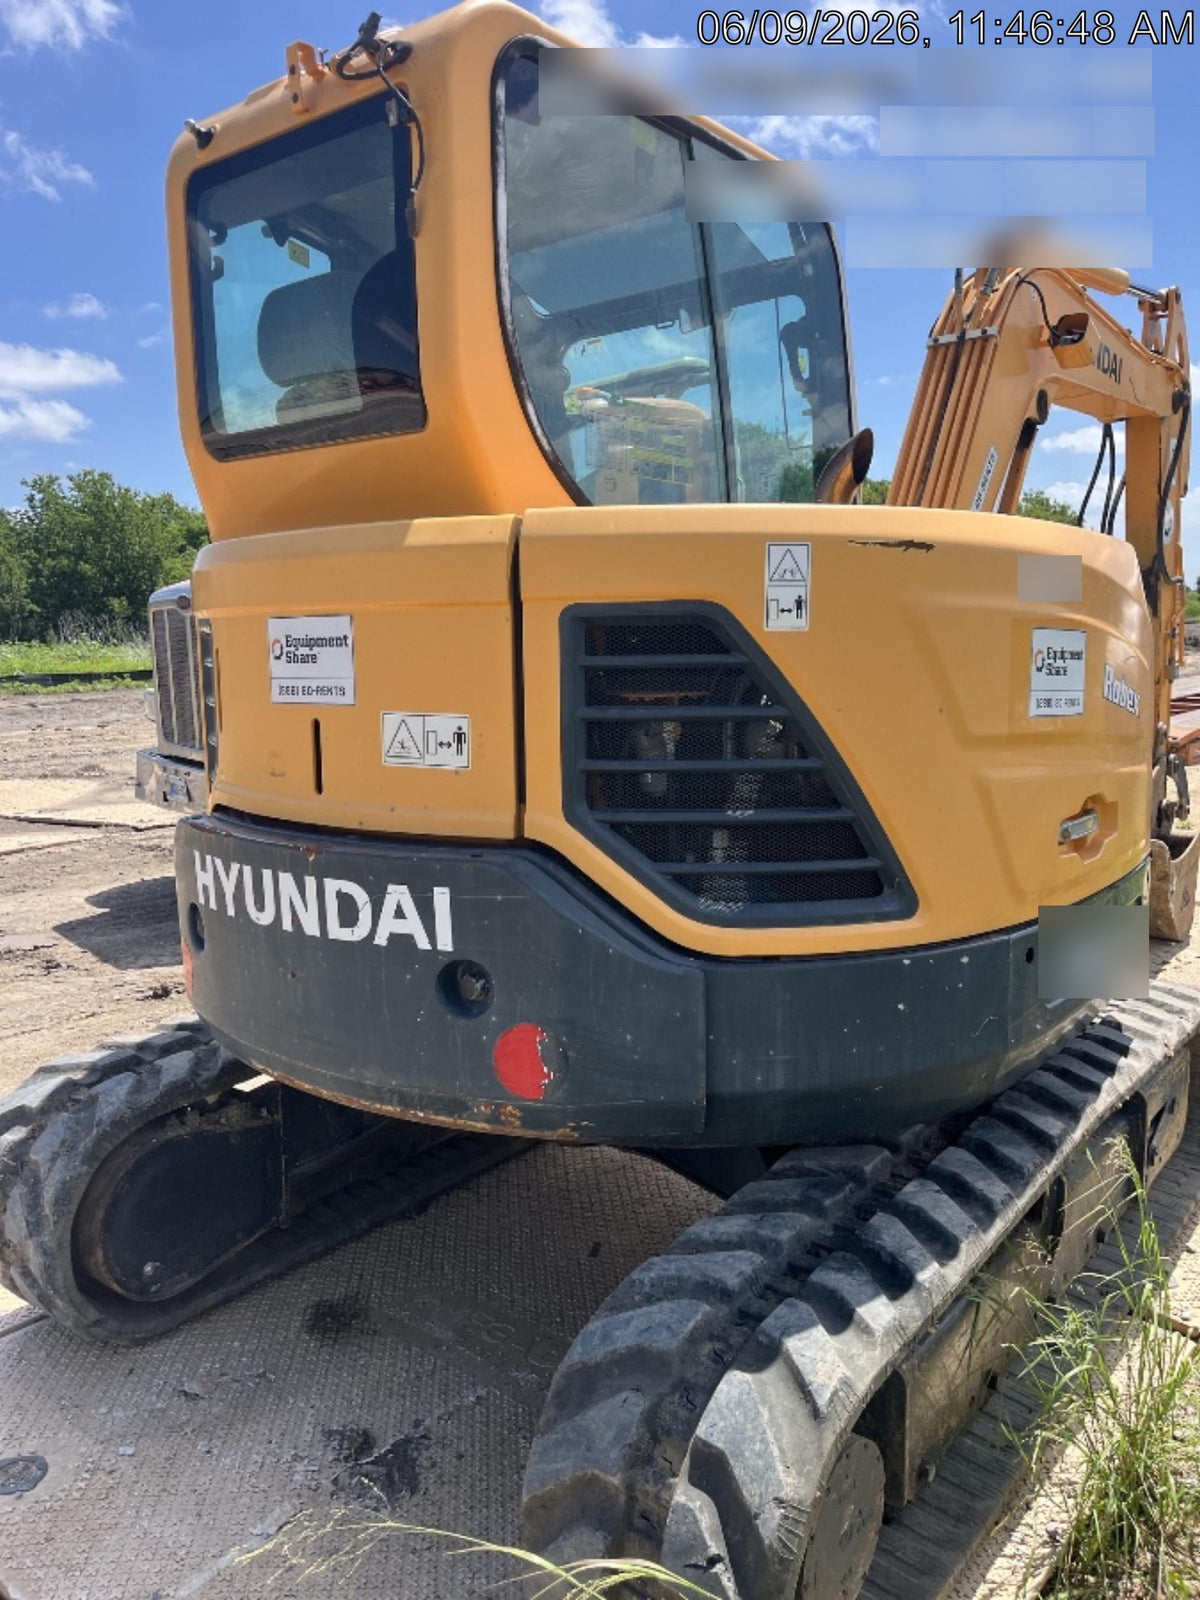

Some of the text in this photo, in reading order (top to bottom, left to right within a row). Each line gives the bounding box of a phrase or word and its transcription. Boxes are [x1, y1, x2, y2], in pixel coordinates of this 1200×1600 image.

[284, 634, 349, 652] Equipment
[285, 651, 318, 664] Share
[193, 849, 454, 952] HYUNDAI
